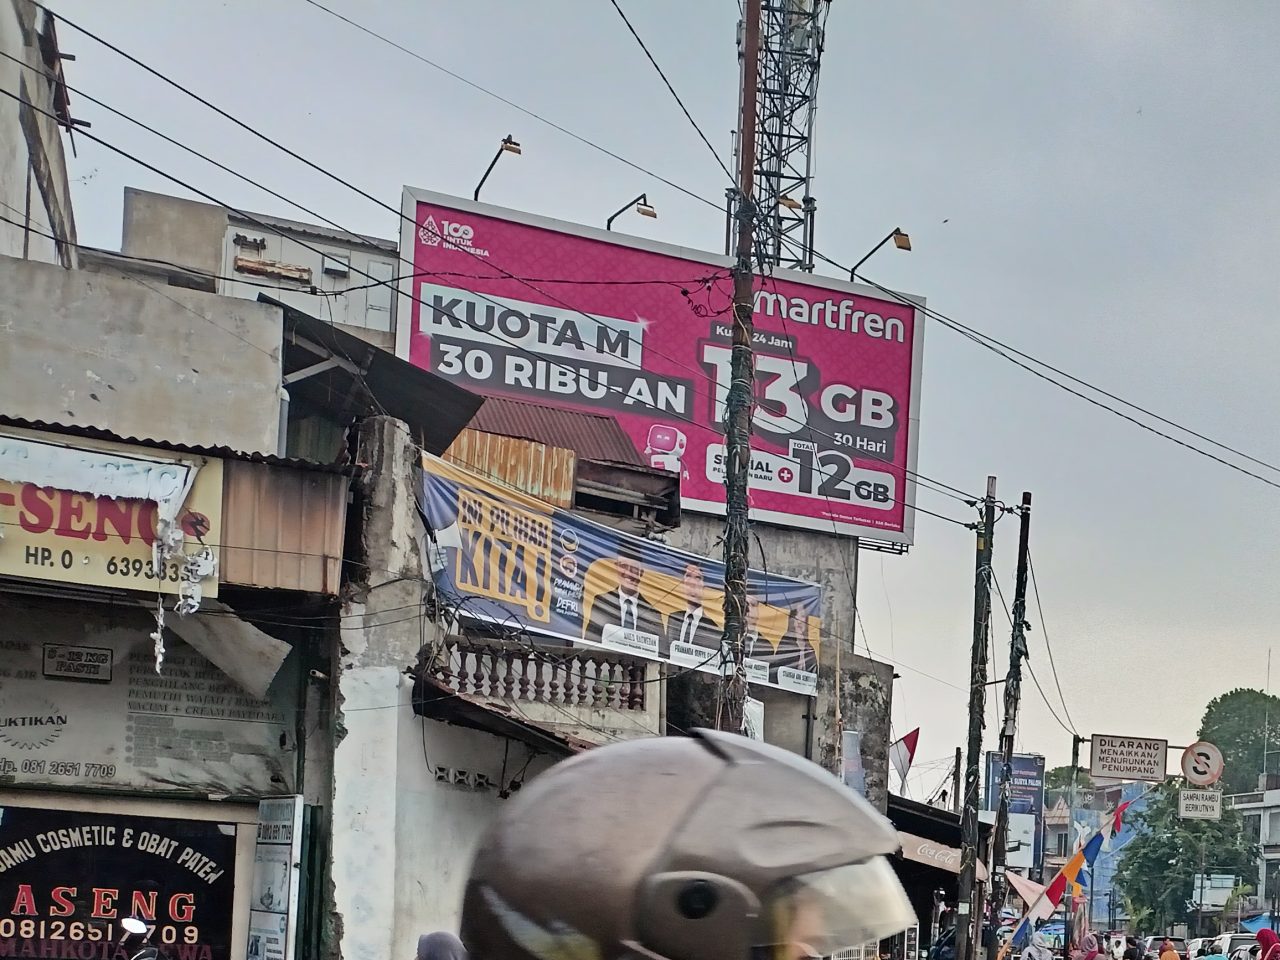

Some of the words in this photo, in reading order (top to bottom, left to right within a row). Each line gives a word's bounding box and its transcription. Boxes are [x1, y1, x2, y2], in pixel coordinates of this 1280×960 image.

[432, 294, 585, 351] KUOTA
[753, 290, 905, 344] martfren
[752, 332, 767, 345] 24
[767, 335, 793, 349] Jam
[437, 343, 494, 380] 30
[504, 354, 687, 415] RIBU-AN
[820, 384, 895, 430] GB
[793, 442, 815, 451] TOTAL
[833, 432, 853, 446] 30
[855, 433, 887, 455] Hari
[792, 448, 851, 501] 12
[854, 480, 890, 503] GB
[24, 546, 55, 567] HP.
[1099, 738, 1160, 751] DILARANG
[1100, 748, 1158, 759] MENAIKKAN/
[20, 759, 46, 774] 081
[47, 761, 81, 777] 2651
[84, 763, 117, 778] 7709
[1098, 756, 1159, 767] MENURUNKAN
[1101, 764, 1155, 775] PENUMPANG
[1201, 793, 1219, 803] RAMBU
[40, 825, 117, 853] COSMETIC
[122, 828, 134, 848] &
[136, 831, 180, 860] OBAT
[180, 846, 226, 885] PATEN
[11, 884, 196, 922] ASENG
